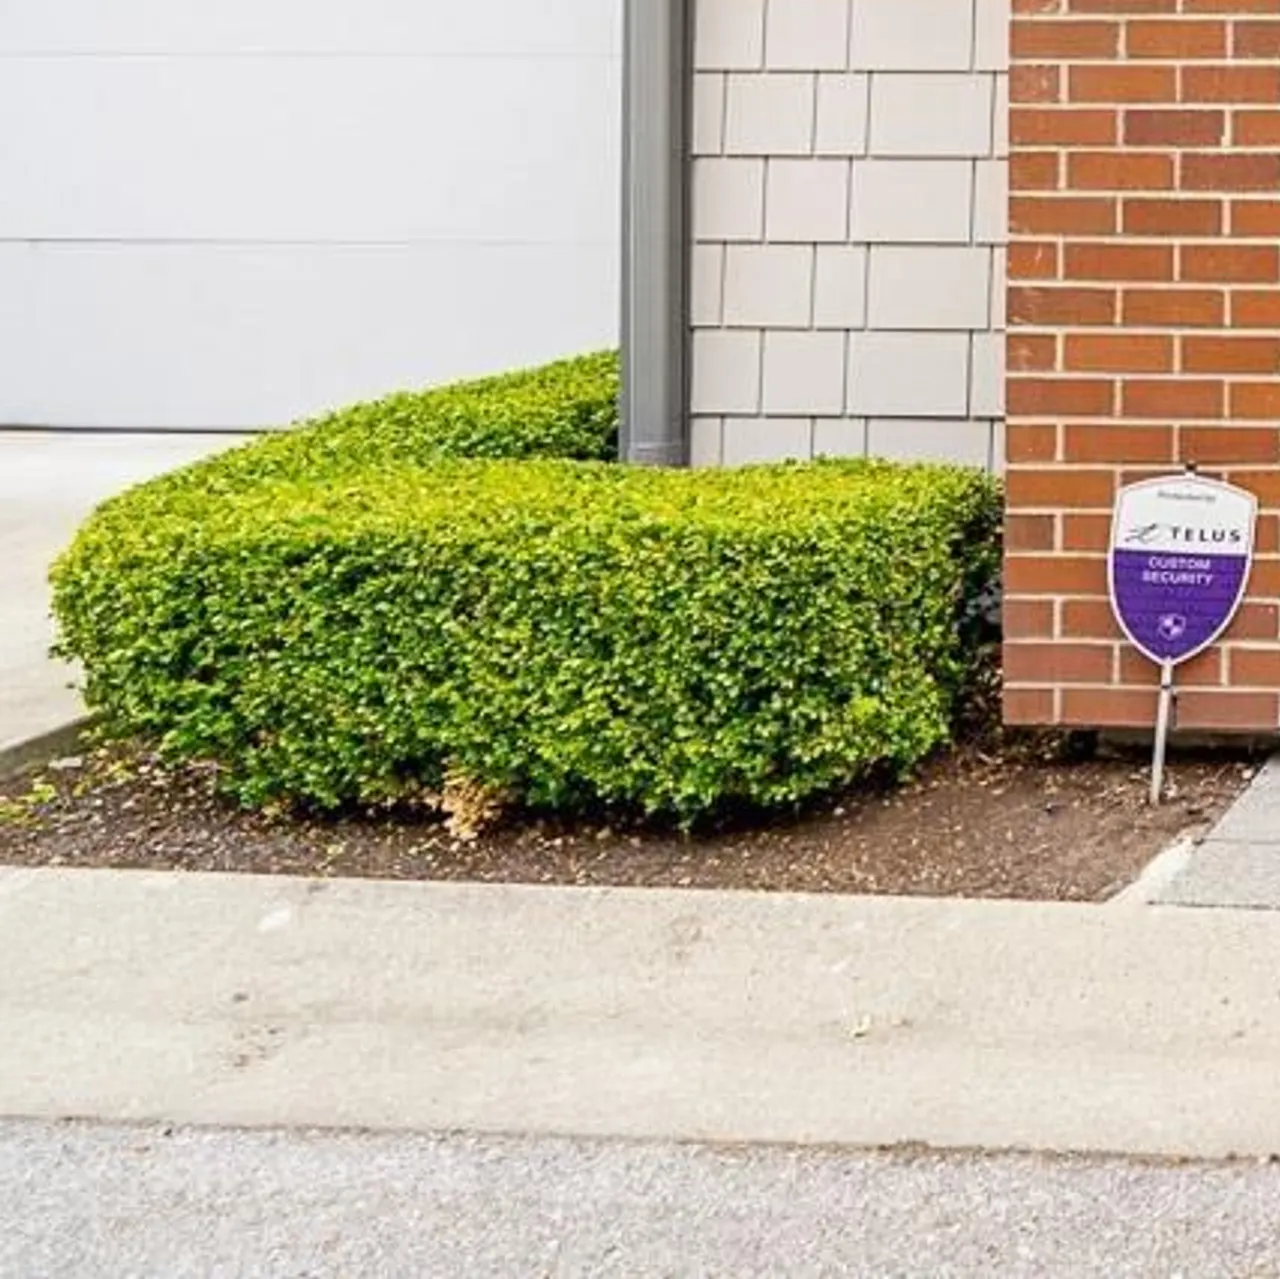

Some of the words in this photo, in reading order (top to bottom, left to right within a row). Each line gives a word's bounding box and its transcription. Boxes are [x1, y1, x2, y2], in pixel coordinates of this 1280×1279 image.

[1170, 526, 1241, 543] TELUS
[1148, 556, 1212, 570] CUSTOM
[1141, 570, 1214, 586] SECURITY
